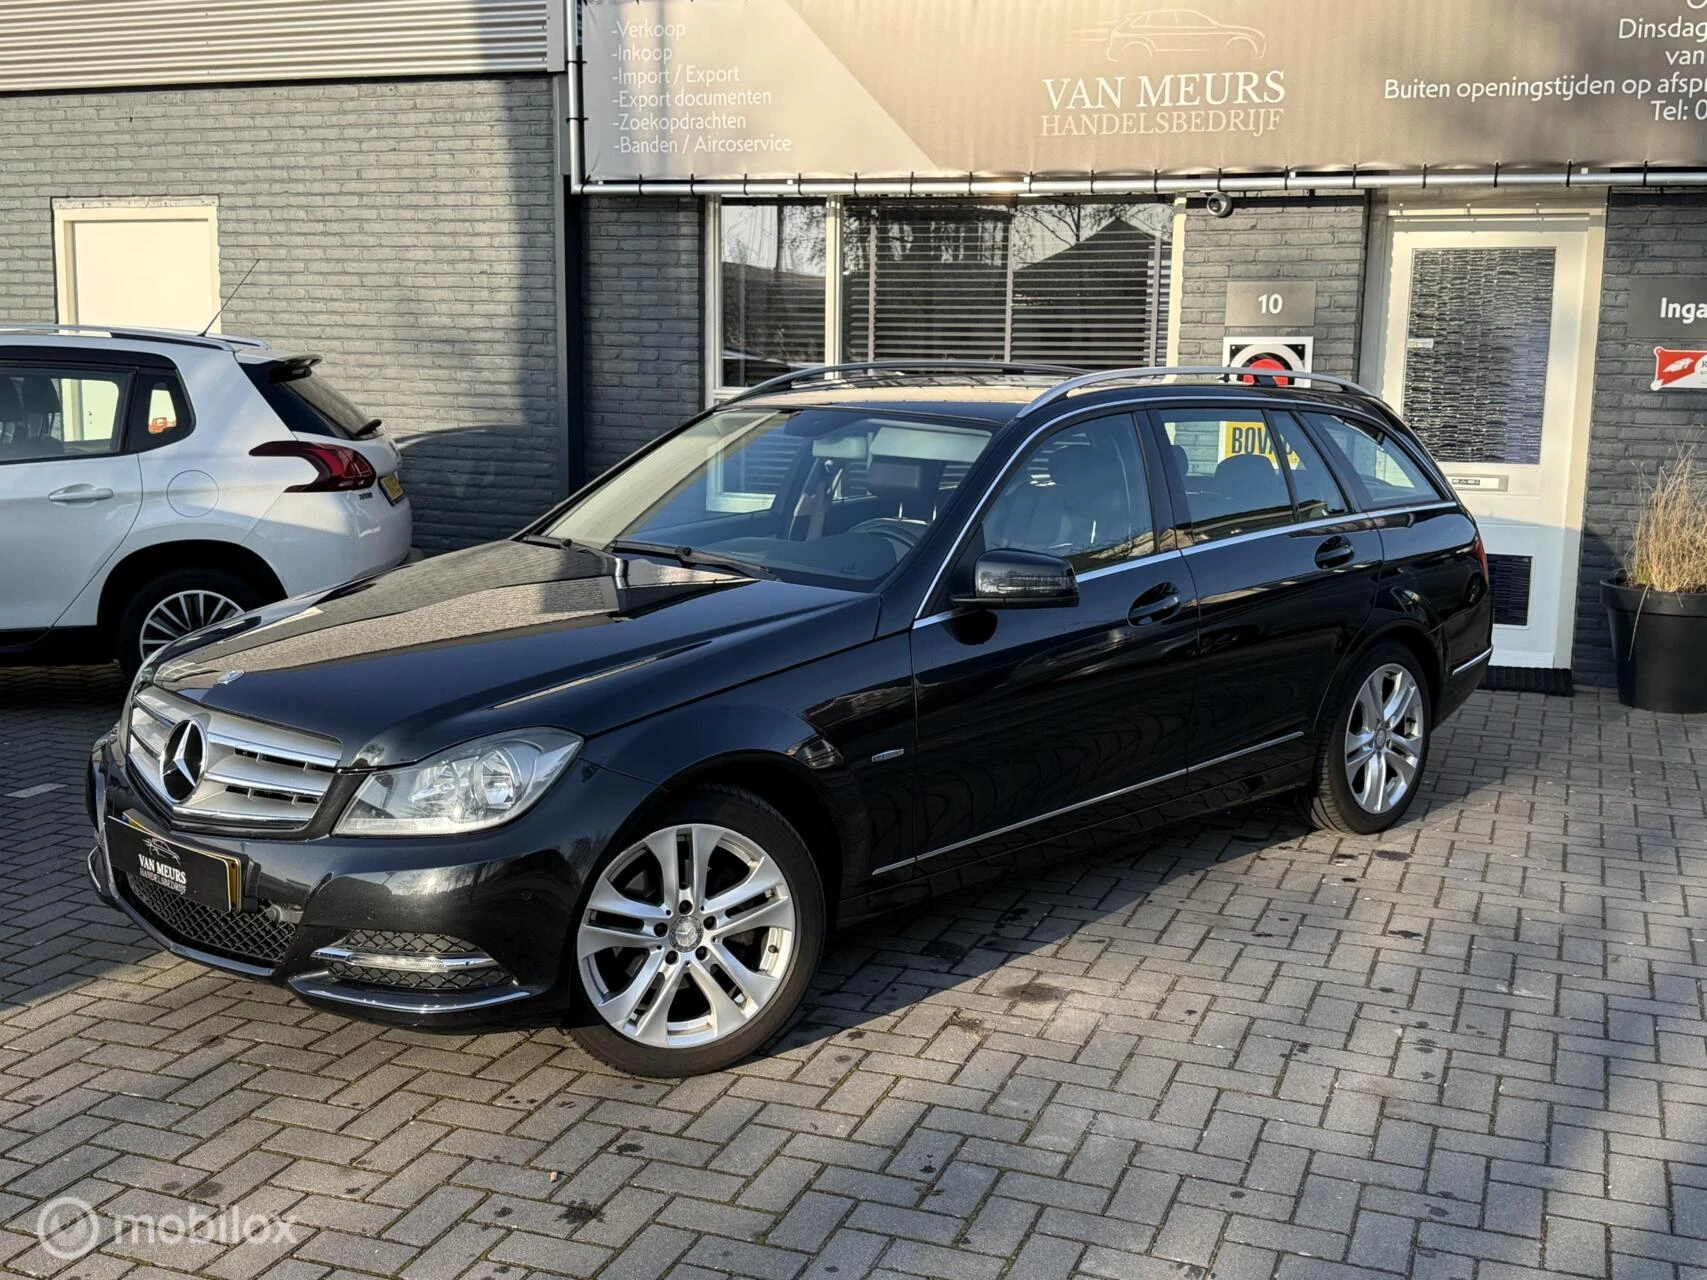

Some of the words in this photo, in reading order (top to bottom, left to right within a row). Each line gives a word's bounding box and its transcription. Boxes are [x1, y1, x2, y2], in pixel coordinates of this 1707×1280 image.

[611, 18, 686, 40] -Verkoop
[1619, 15, 1707, 43] Dinsdag
[611, 43, 673, 64] -Inkoop
[1665, 50, 1705, 65] van
[612, 67, 671, 88] -Import
[686, 65, 740, 87] Export
[1384, 78, 1450, 99] Buiten
[1456, 73, 1615, 102] openingstijden
[1621, 78, 1651, 100] op
[612, 90, 671, 112] -Export
[674, 89, 772, 107] documenten
[1041, 76, 1125, 111] VAN
[1136, 70, 1286, 108] MEURS
[613, 110, 746, 133] -Zoekopdrachten
[1650, 99, 1689, 121] Tel:
[1040, 108, 1284, 137] HANDELSBEDRIJF
[613, 135, 678, 153] -Banden
[694, 133, 792, 152] Aircoservice
[1258, 293, 1284, 314] 10
[1660, 297, 1707, 324] Inga
[138, 853, 155, 872] VAN
[156, 861, 187, 884] MEURS
